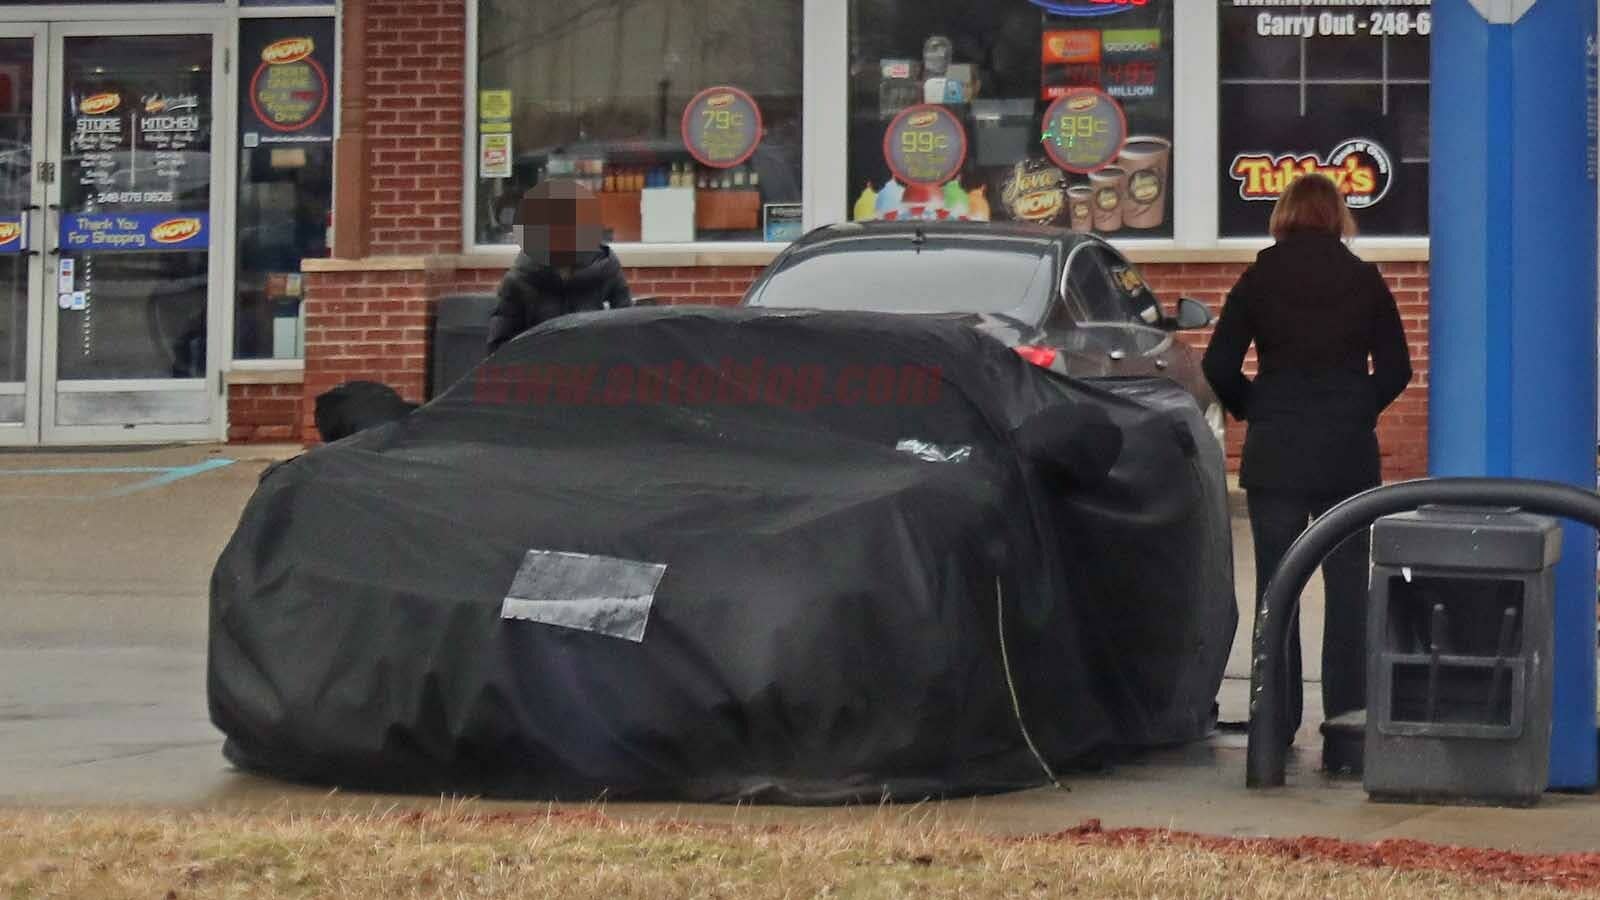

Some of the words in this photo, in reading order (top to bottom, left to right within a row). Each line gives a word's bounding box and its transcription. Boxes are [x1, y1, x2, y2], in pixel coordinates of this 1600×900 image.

[1257, 12, 1315, 37] Carry
[1319, 12, 1356, 36] Out
[1370, 12, 1431, 36] 248-6
[1107, 86, 1154, 97] MILLION
[77, 118, 121, 130] STORE
[141, 117, 199, 130] KITCHEN
[1236, 157, 1376, 194] Tuby's
[77, 218, 113, 230] Thank
[116, 218, 138, 230] You
[68, 232, 90, 244] For
[92, 231, 145, 247] Shopping
